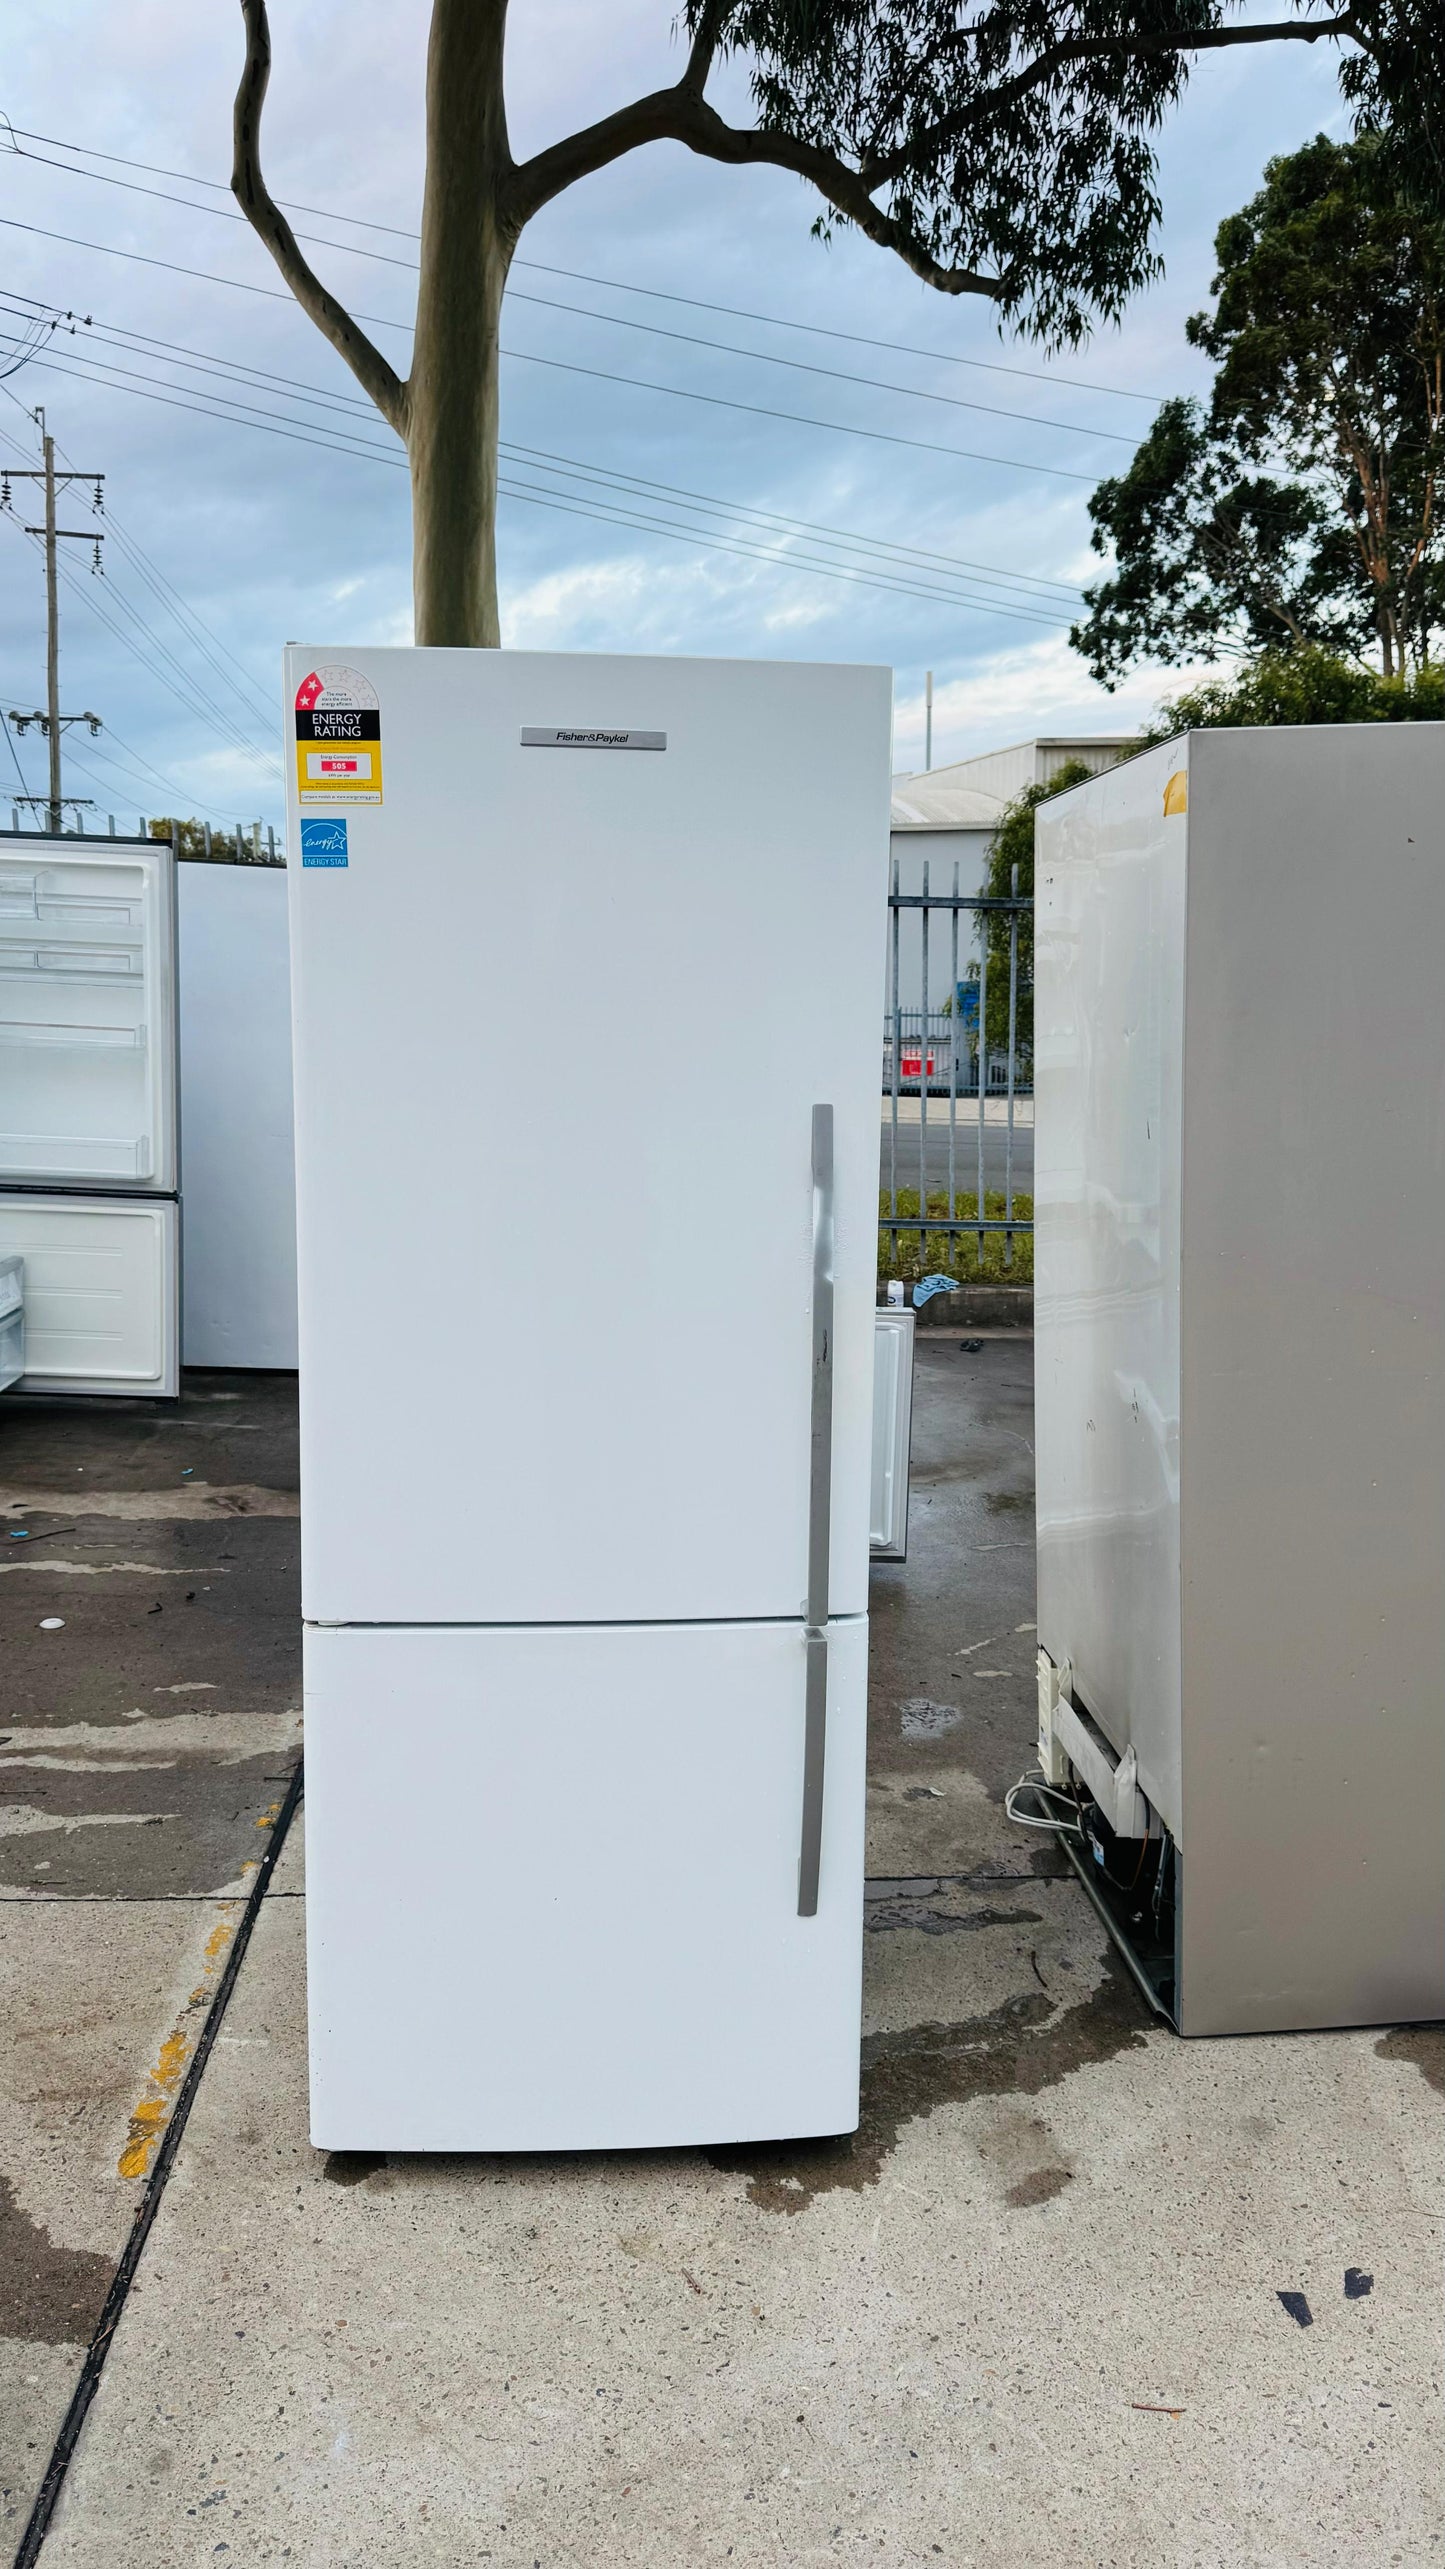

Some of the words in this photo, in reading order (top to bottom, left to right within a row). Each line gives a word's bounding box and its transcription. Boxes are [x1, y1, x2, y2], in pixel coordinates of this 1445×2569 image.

[312, 713, 362, 725] ENERGY
[314, 725, 361, 737] RATING
[556, 732, 629, 744] Fisher&Paykel
[332, 762, 347, 770] 505
